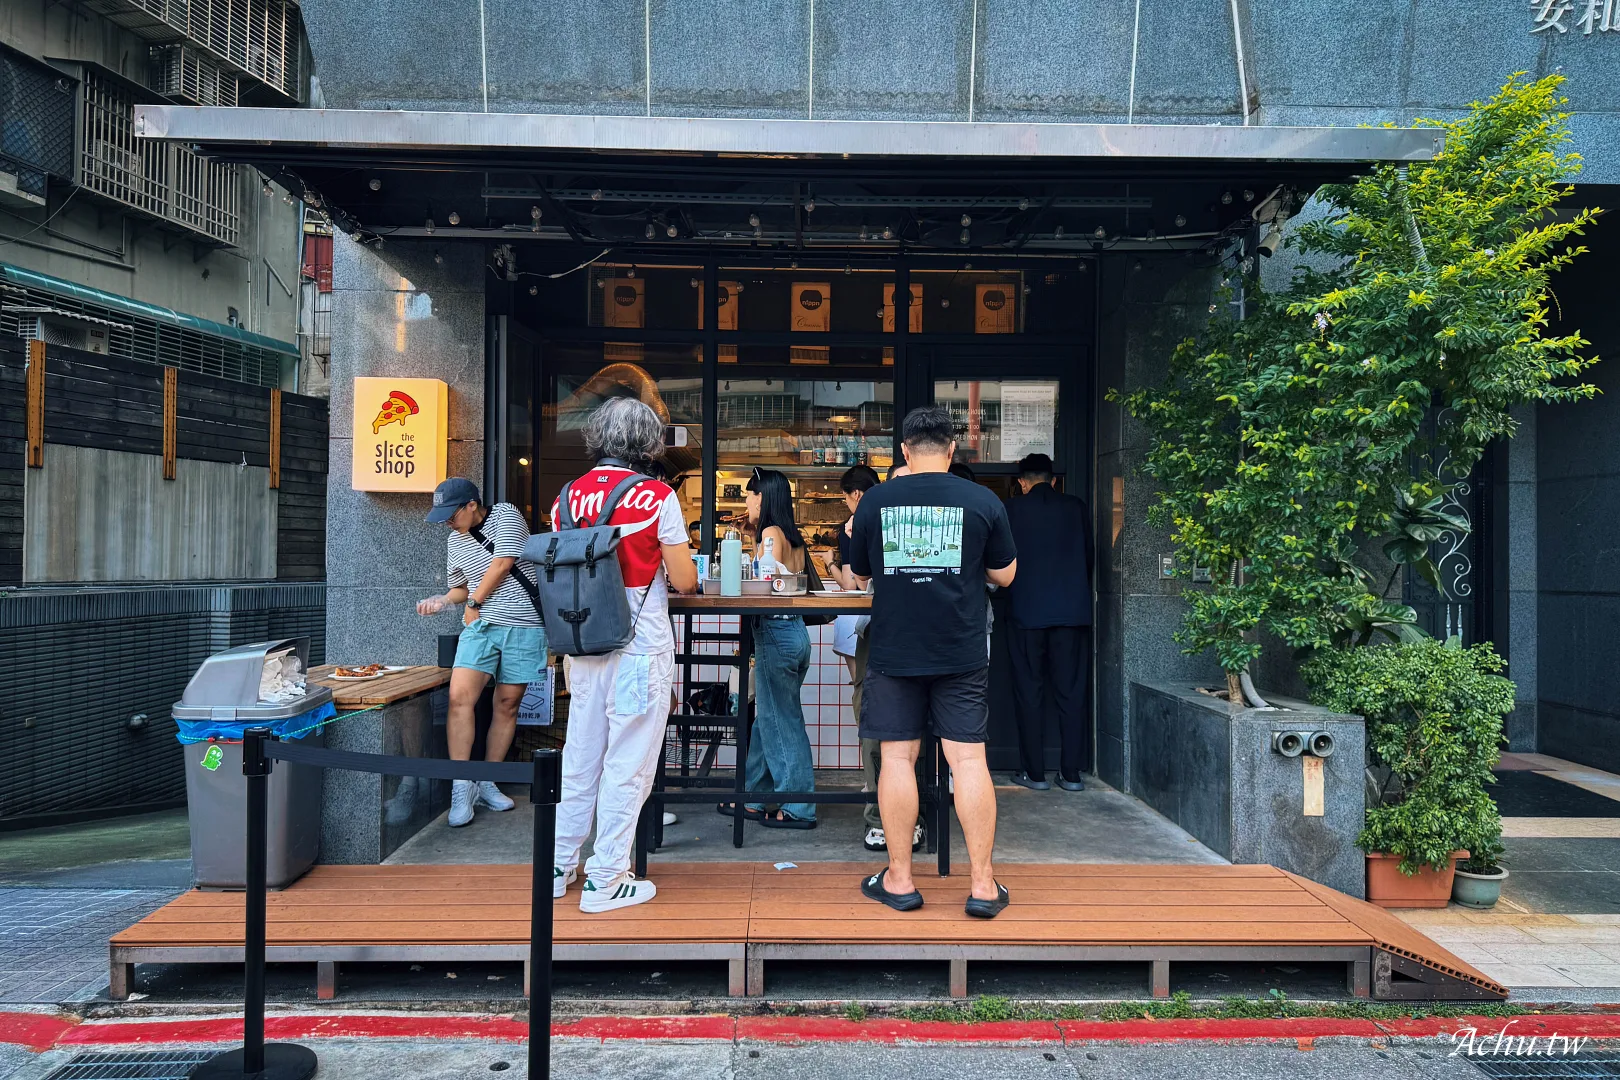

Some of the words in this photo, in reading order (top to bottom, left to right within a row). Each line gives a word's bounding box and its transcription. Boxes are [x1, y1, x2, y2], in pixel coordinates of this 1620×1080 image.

[401, 433, 415, 441] the
[375, 440, 415, 458] slice
[375, 456, 415, 478] shop
